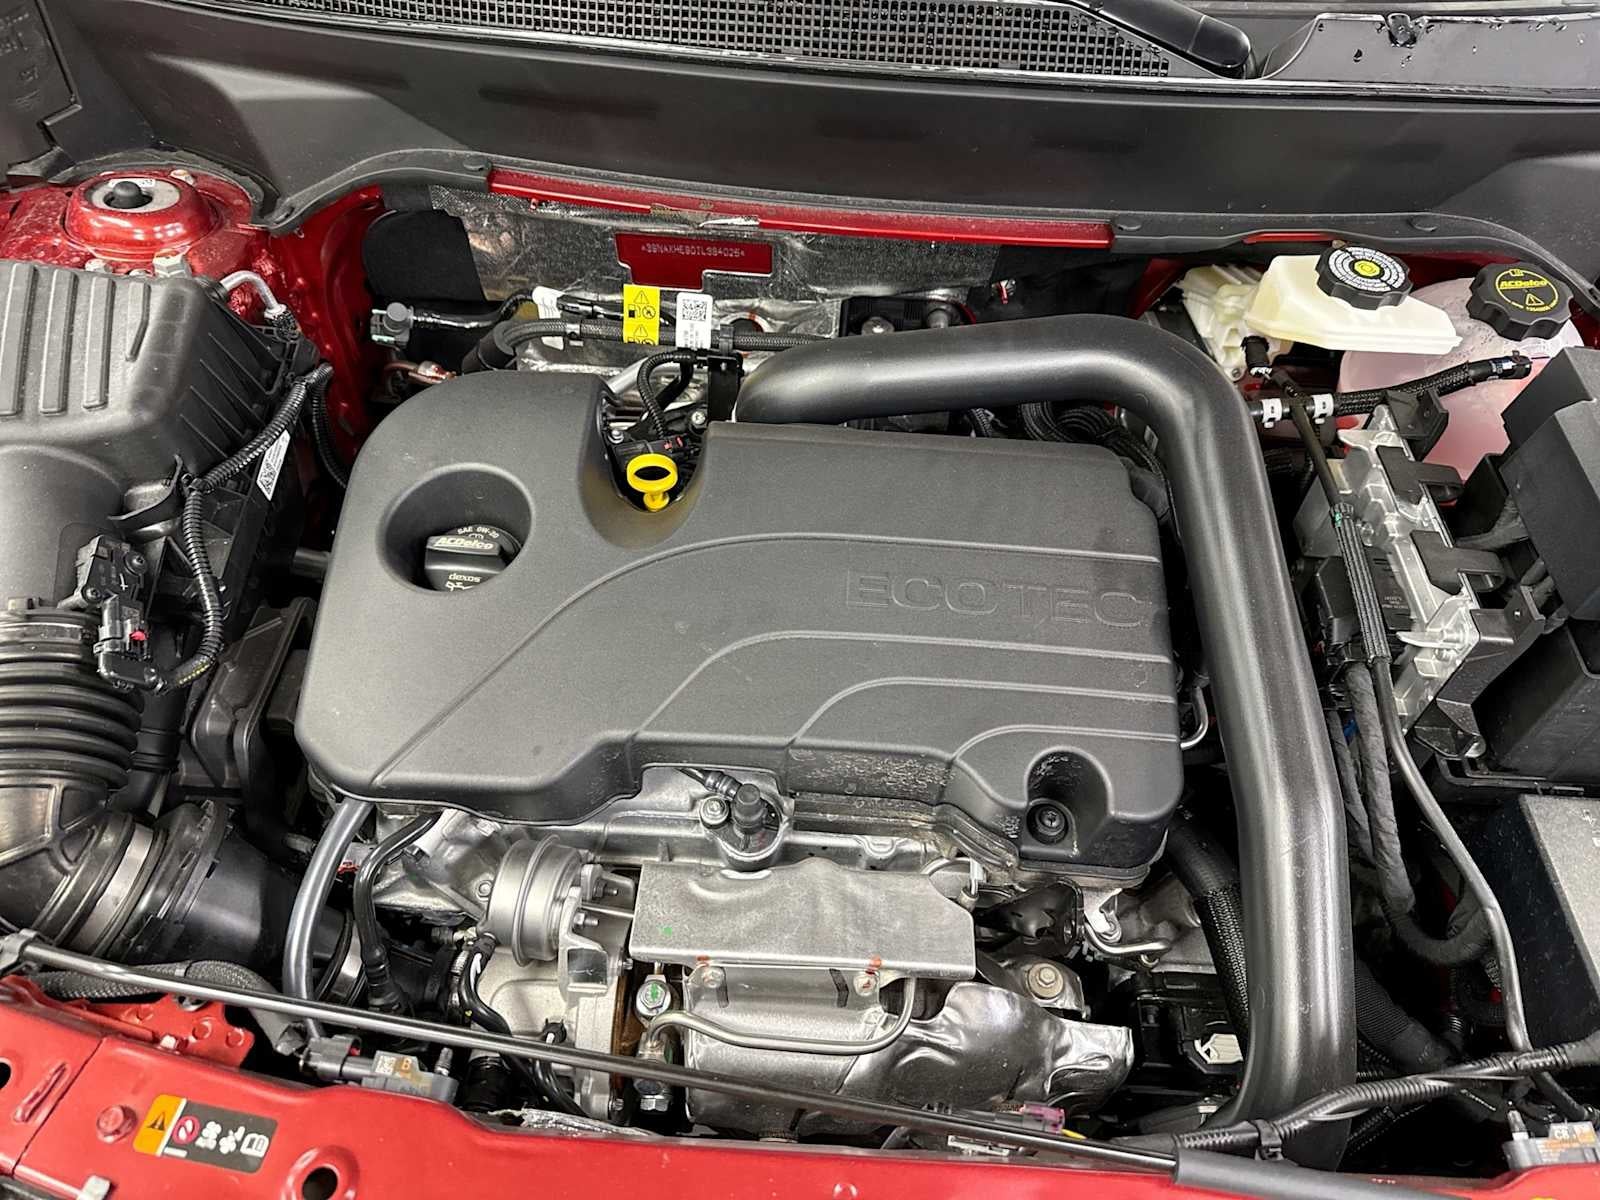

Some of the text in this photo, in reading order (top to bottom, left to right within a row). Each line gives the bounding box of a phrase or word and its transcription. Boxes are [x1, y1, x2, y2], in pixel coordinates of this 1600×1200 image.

[457, 526, 473, 535] SAE
[434, 537, 494, 549] ACDelco
[449, 573, 482, 583] dexos
[846, 571, 1153, 627] ECOTEC
